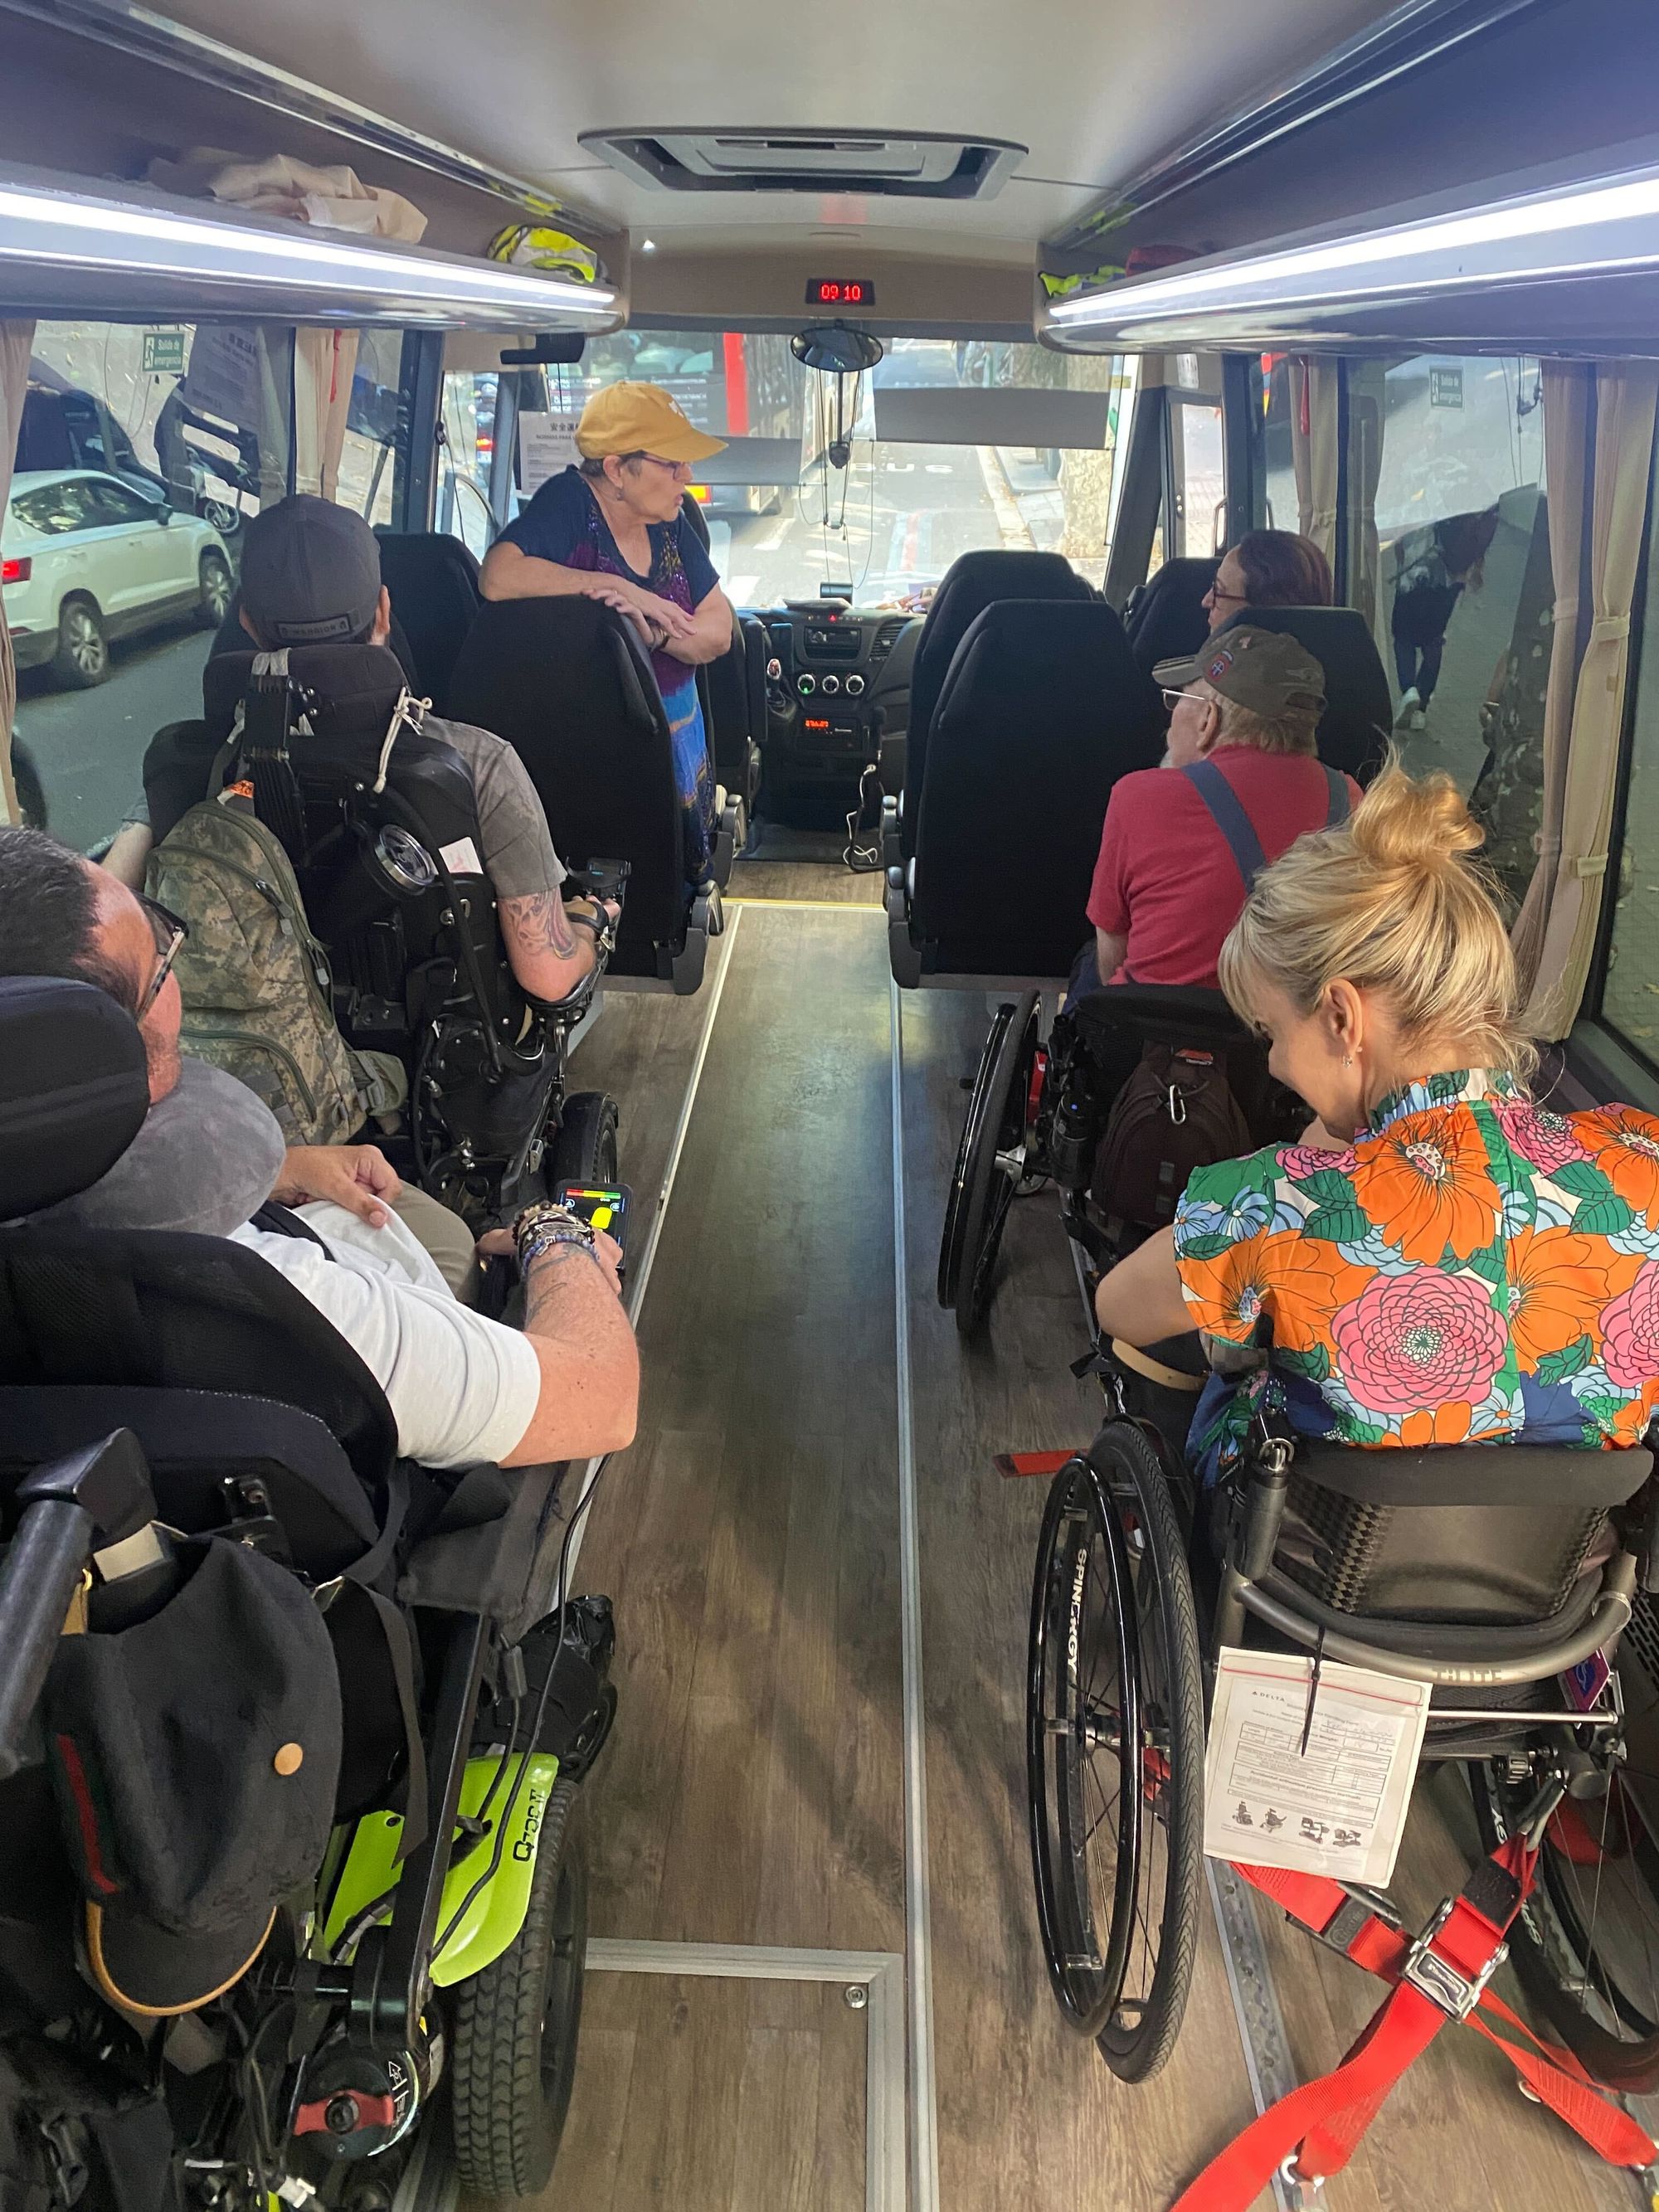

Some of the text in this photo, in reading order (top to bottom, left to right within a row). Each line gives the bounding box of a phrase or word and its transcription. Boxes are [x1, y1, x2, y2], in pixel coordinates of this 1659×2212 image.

[158, 338, 180, 351] Salida de
[154, 356, 182, 368] emergencia
[849, 463, 954, 474] BUS
[1067, 1548, 1087, 1674] SPINERGY
[1259, 1692, 1286, 1703] DELTA
